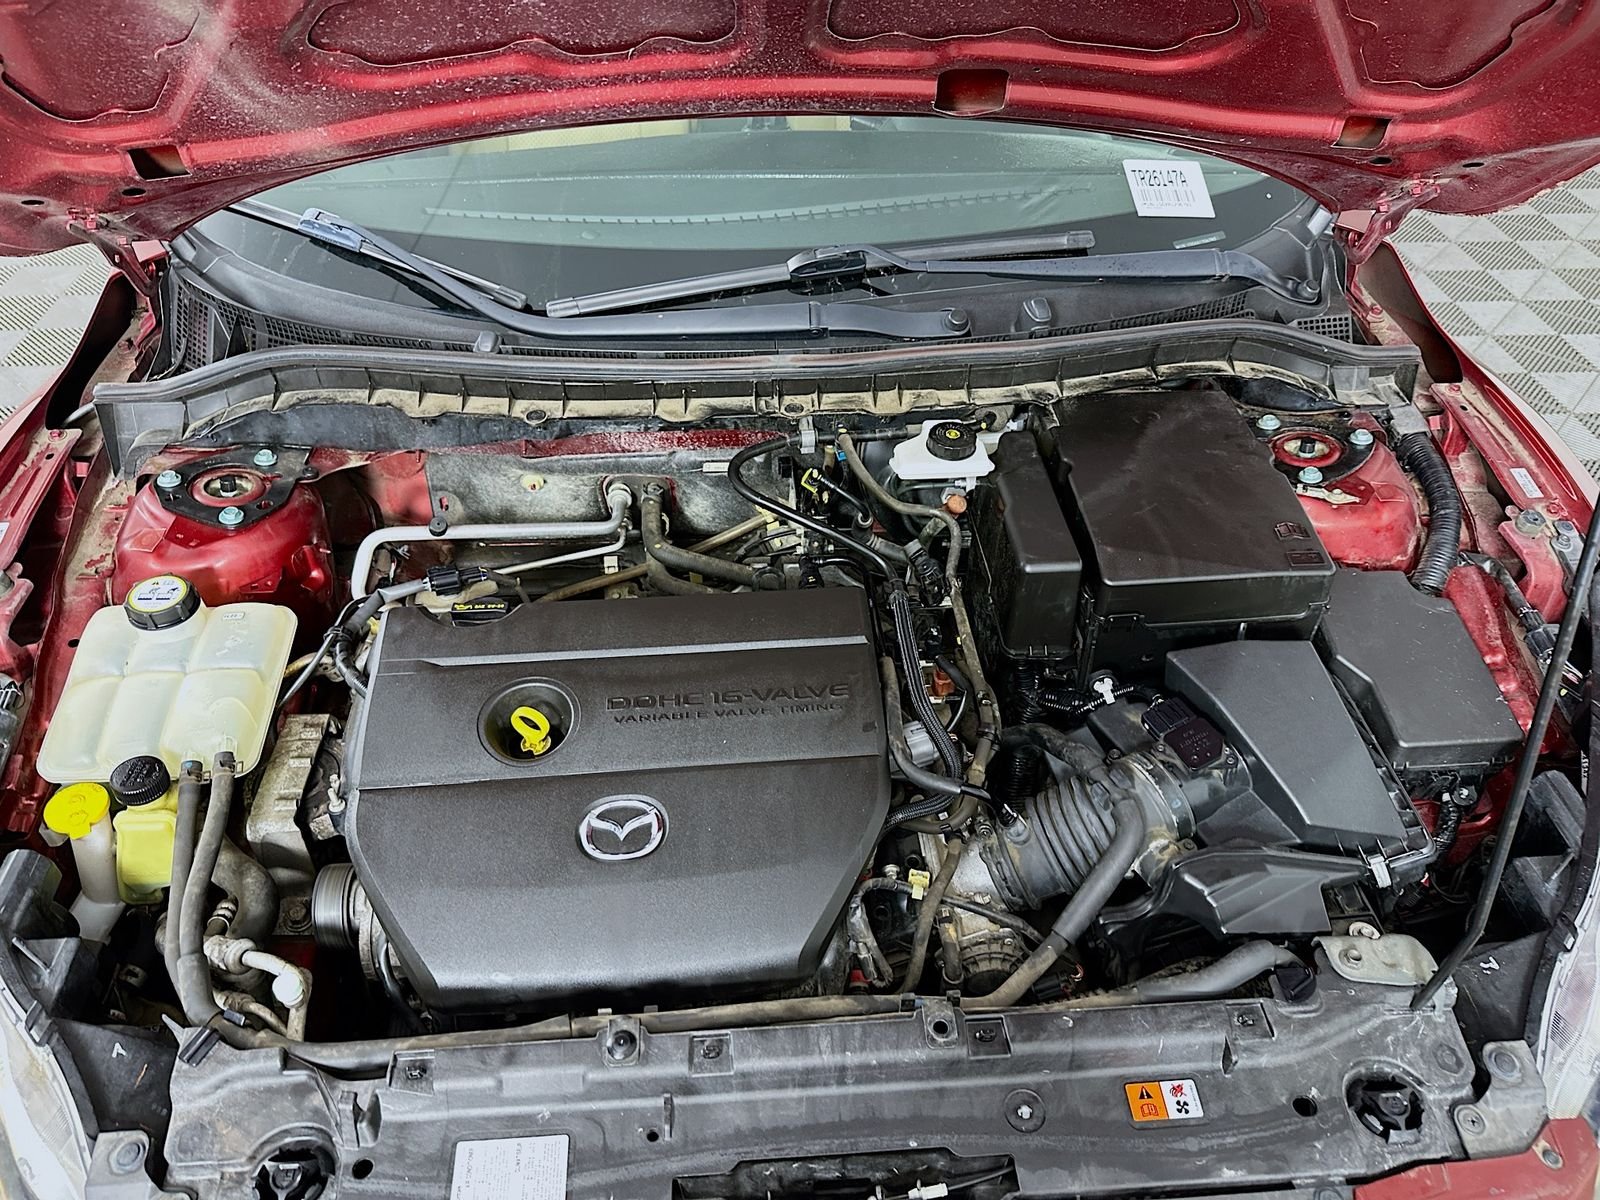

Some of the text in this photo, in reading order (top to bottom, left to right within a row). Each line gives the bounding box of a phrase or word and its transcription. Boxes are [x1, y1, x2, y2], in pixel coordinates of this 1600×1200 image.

[1131, 169, 1189, 187] TR26147A
[605, 683, 850, 711] DOHC 16-VALVE
[613, 703, 844, 724] VARIABLE VALVE TIMING
